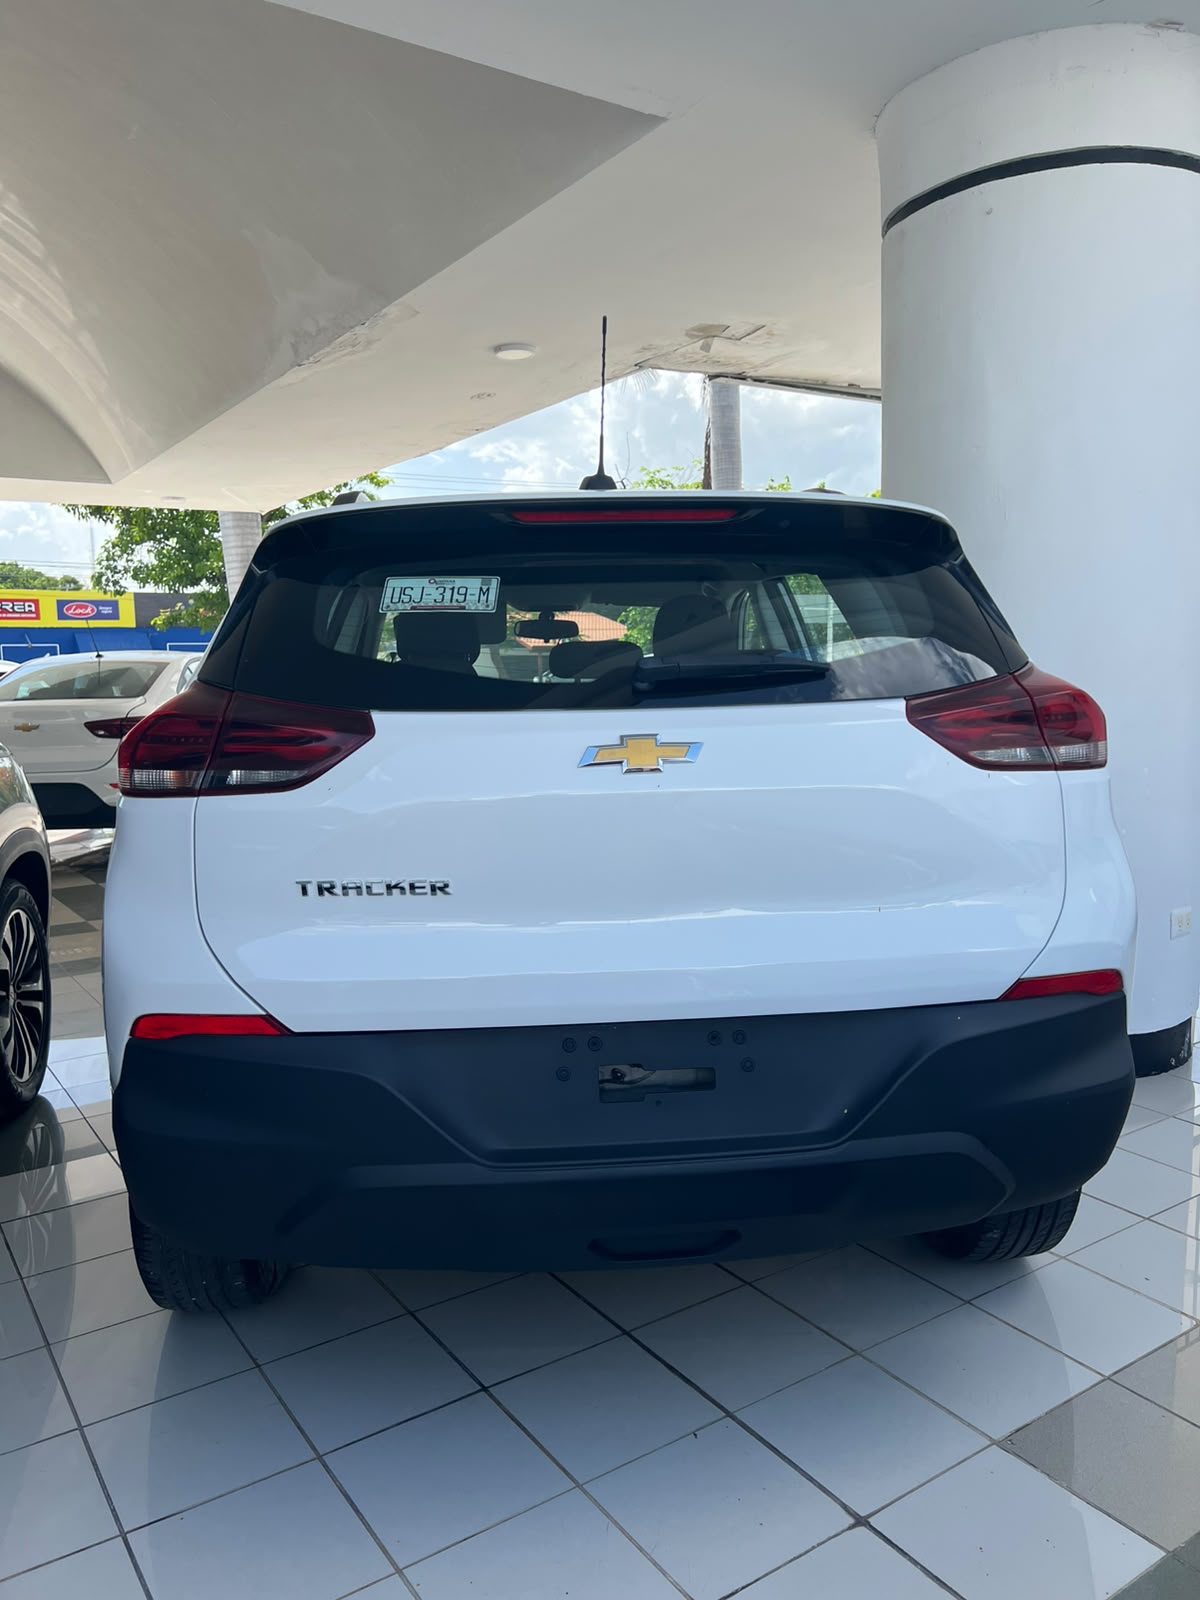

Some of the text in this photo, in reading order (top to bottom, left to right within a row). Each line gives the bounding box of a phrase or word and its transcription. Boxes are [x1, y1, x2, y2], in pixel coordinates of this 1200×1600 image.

[390, 586, 490, 604] USJ-319-M
[0, 601, 36, 612] REA
[68, 605, 93, 614] Lock
[295, 879, 453, 897] TRACKER
